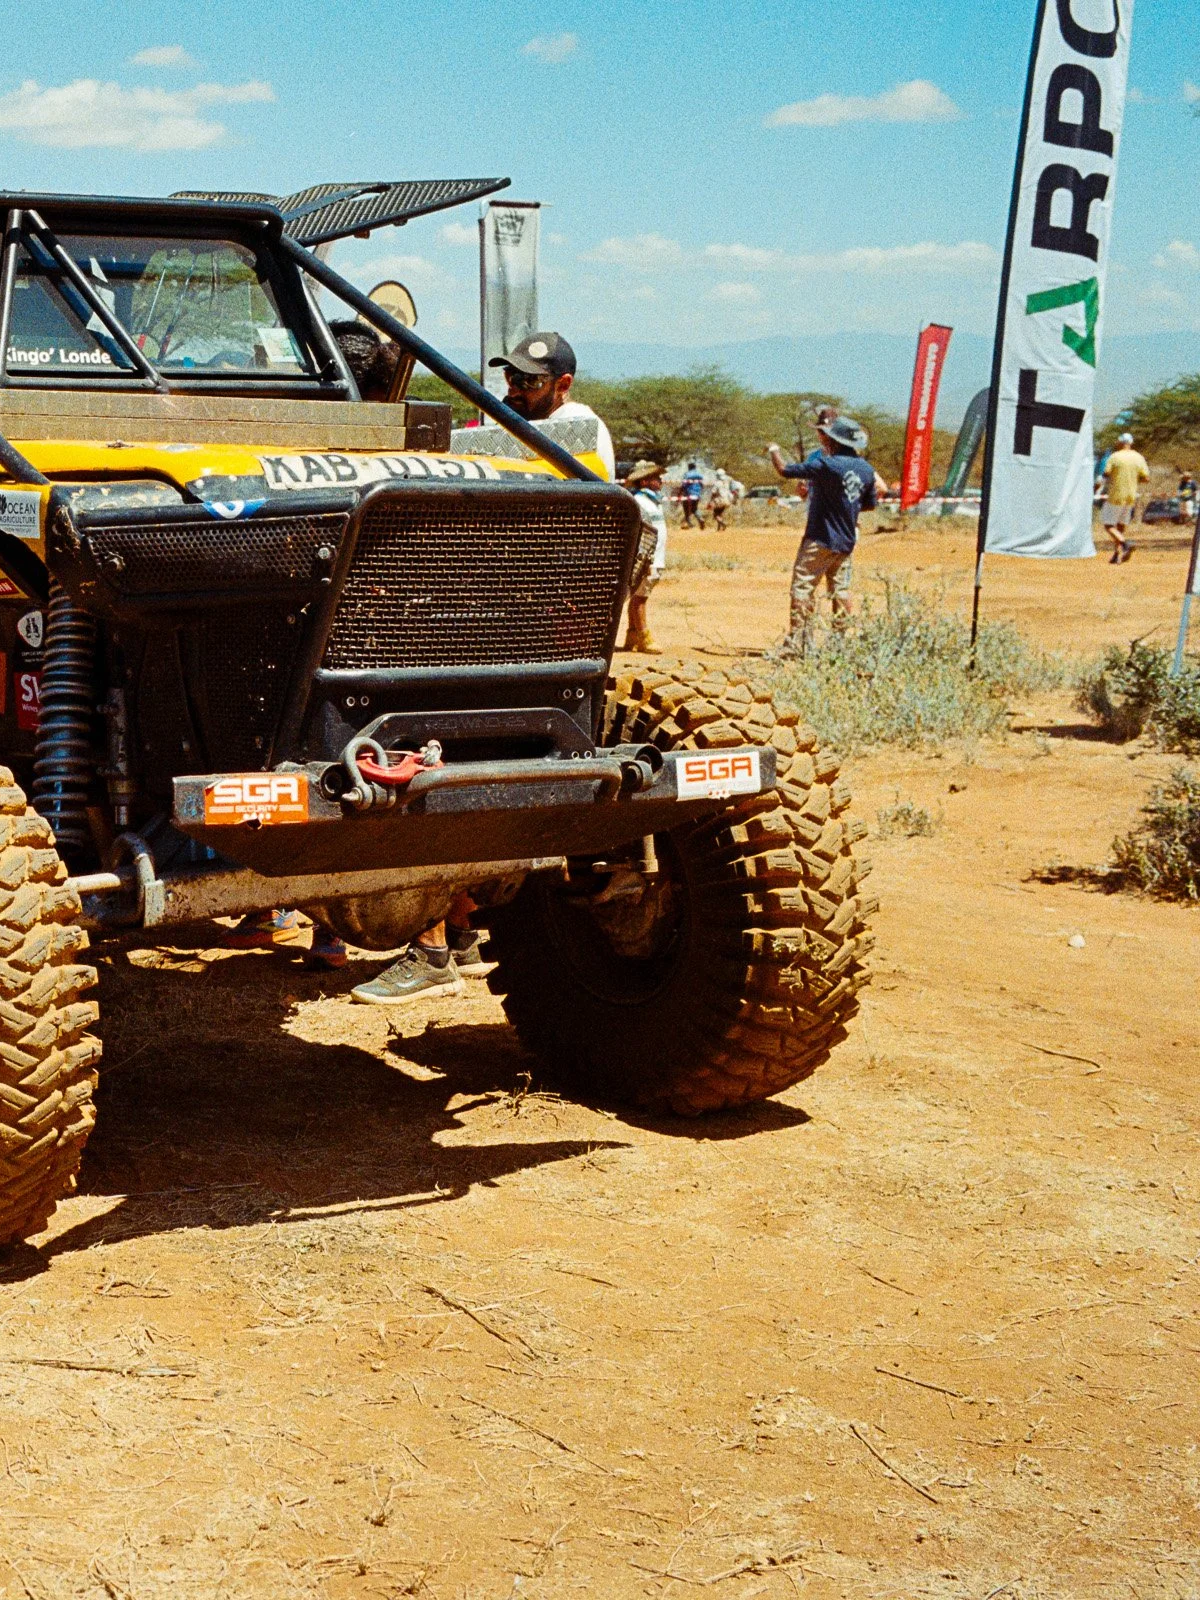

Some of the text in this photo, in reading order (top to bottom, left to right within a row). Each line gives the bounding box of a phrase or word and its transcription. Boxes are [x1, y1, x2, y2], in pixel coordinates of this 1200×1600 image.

[60, 348, 112, 364] Londe
[263, 454, 358, 483] KAB
[7, 502, 36, 515] OCEAN
[684, 757, 752, 783] SGA
[213, 777, 299, 804] SGA
[235, 804, 279, 813] SECURITY
